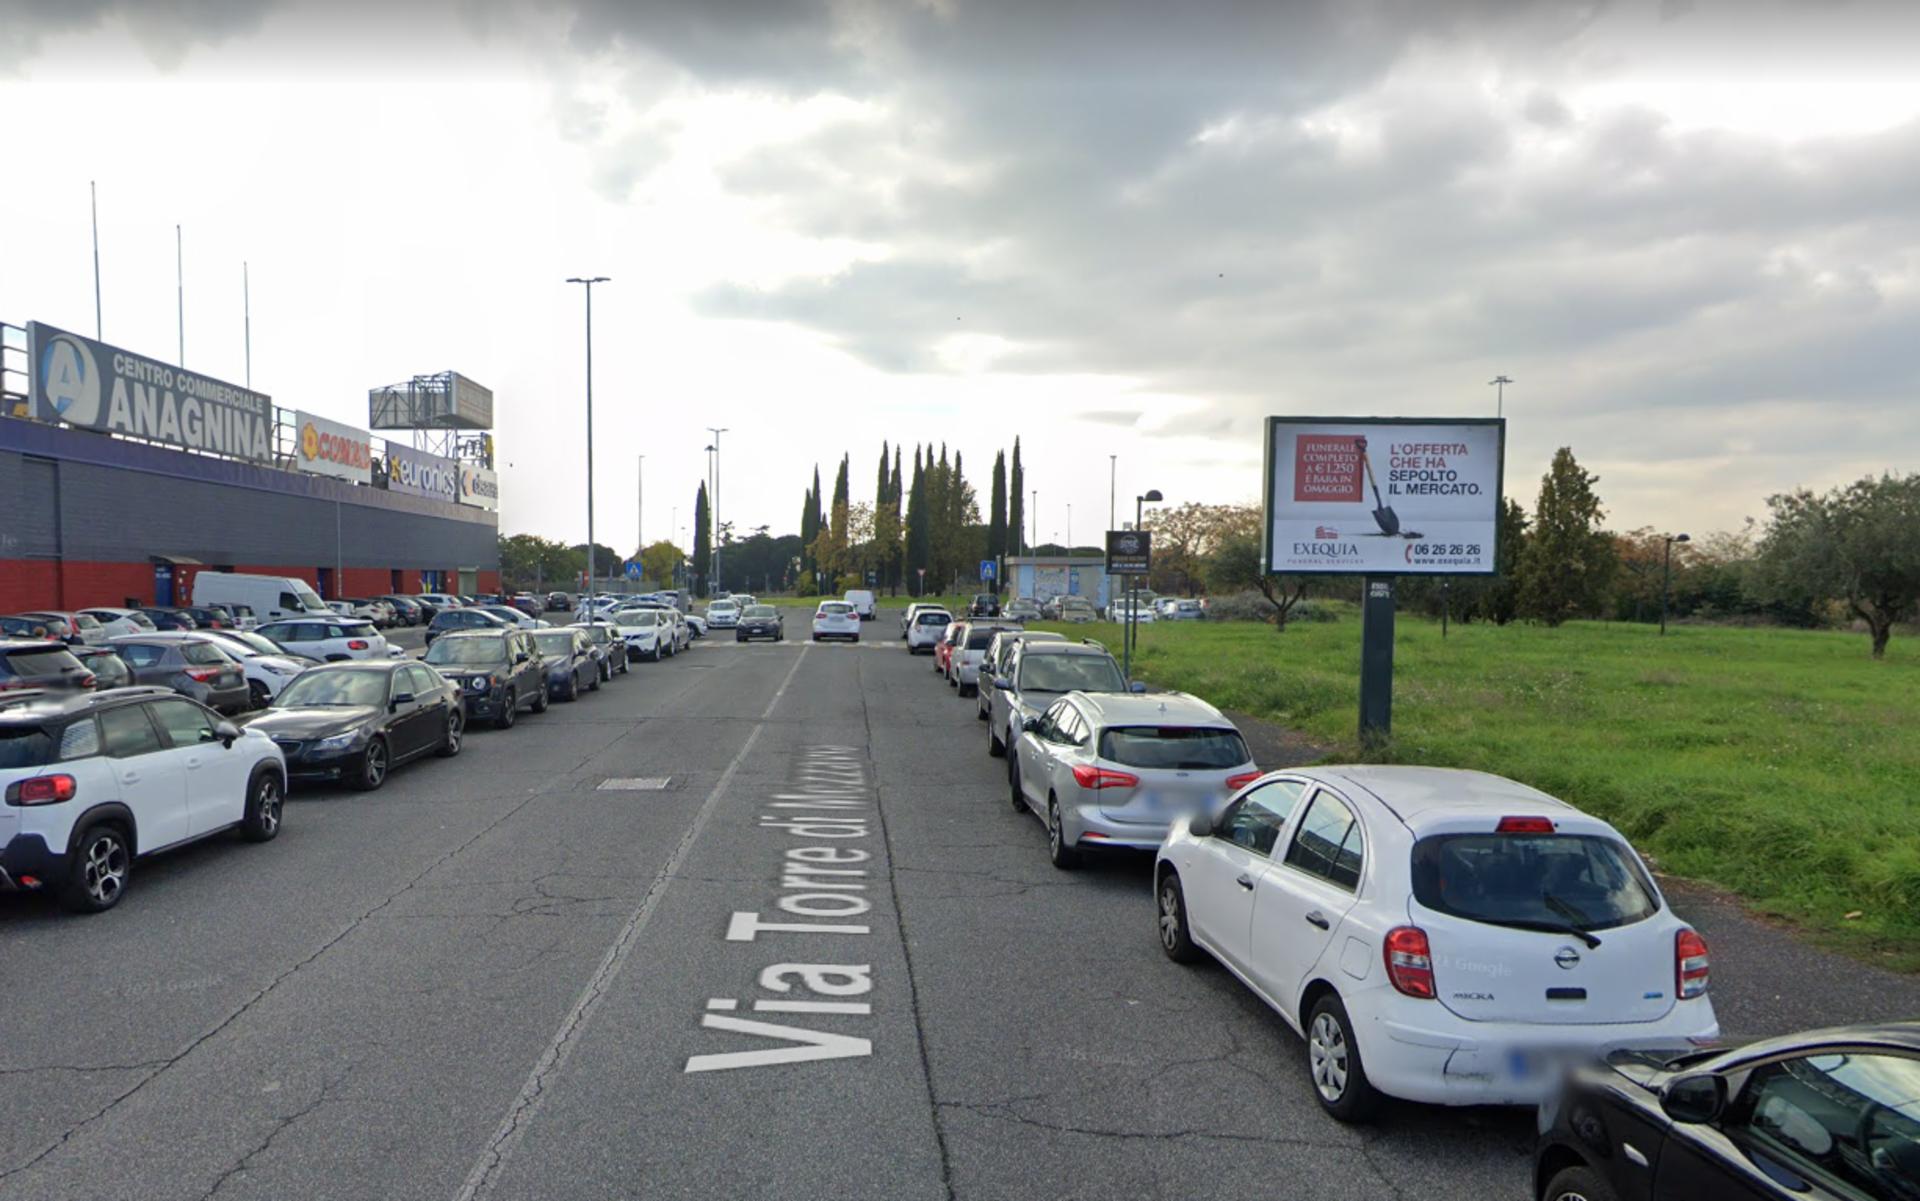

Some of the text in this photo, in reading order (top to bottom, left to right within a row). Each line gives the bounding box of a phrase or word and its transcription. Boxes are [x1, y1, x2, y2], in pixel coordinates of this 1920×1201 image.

[113, 353, 263, 414] CENTRO COMMERCIALE
[107, 378, 270, 461] ANAGNINA
[1306, 443, 1356, 452] FUNERALE
[1390, 443, 1468, 455] L'OFFERTA
[1303, 454, 1359, 463] COMPLETO
[1390, 457, 1446, 468] CHE HA
[1315, 464, 1324, 473] €
[400, 458, 456, 496] euronics
[1305, 475, 1352, 483] E BARA IN
[1389, 470, 1457, 482] SEPOLTO
[1304, 484, 1353, 494] OMAGGIO
[1389, 483, 1483, 495] IL MERCATO.
[1293, 543, 1358, 558] EXEQUIA
[1414, 544, 1481, 555] 06 26 26 26
[1414, 557, 1481, 566] www.exequia.it
